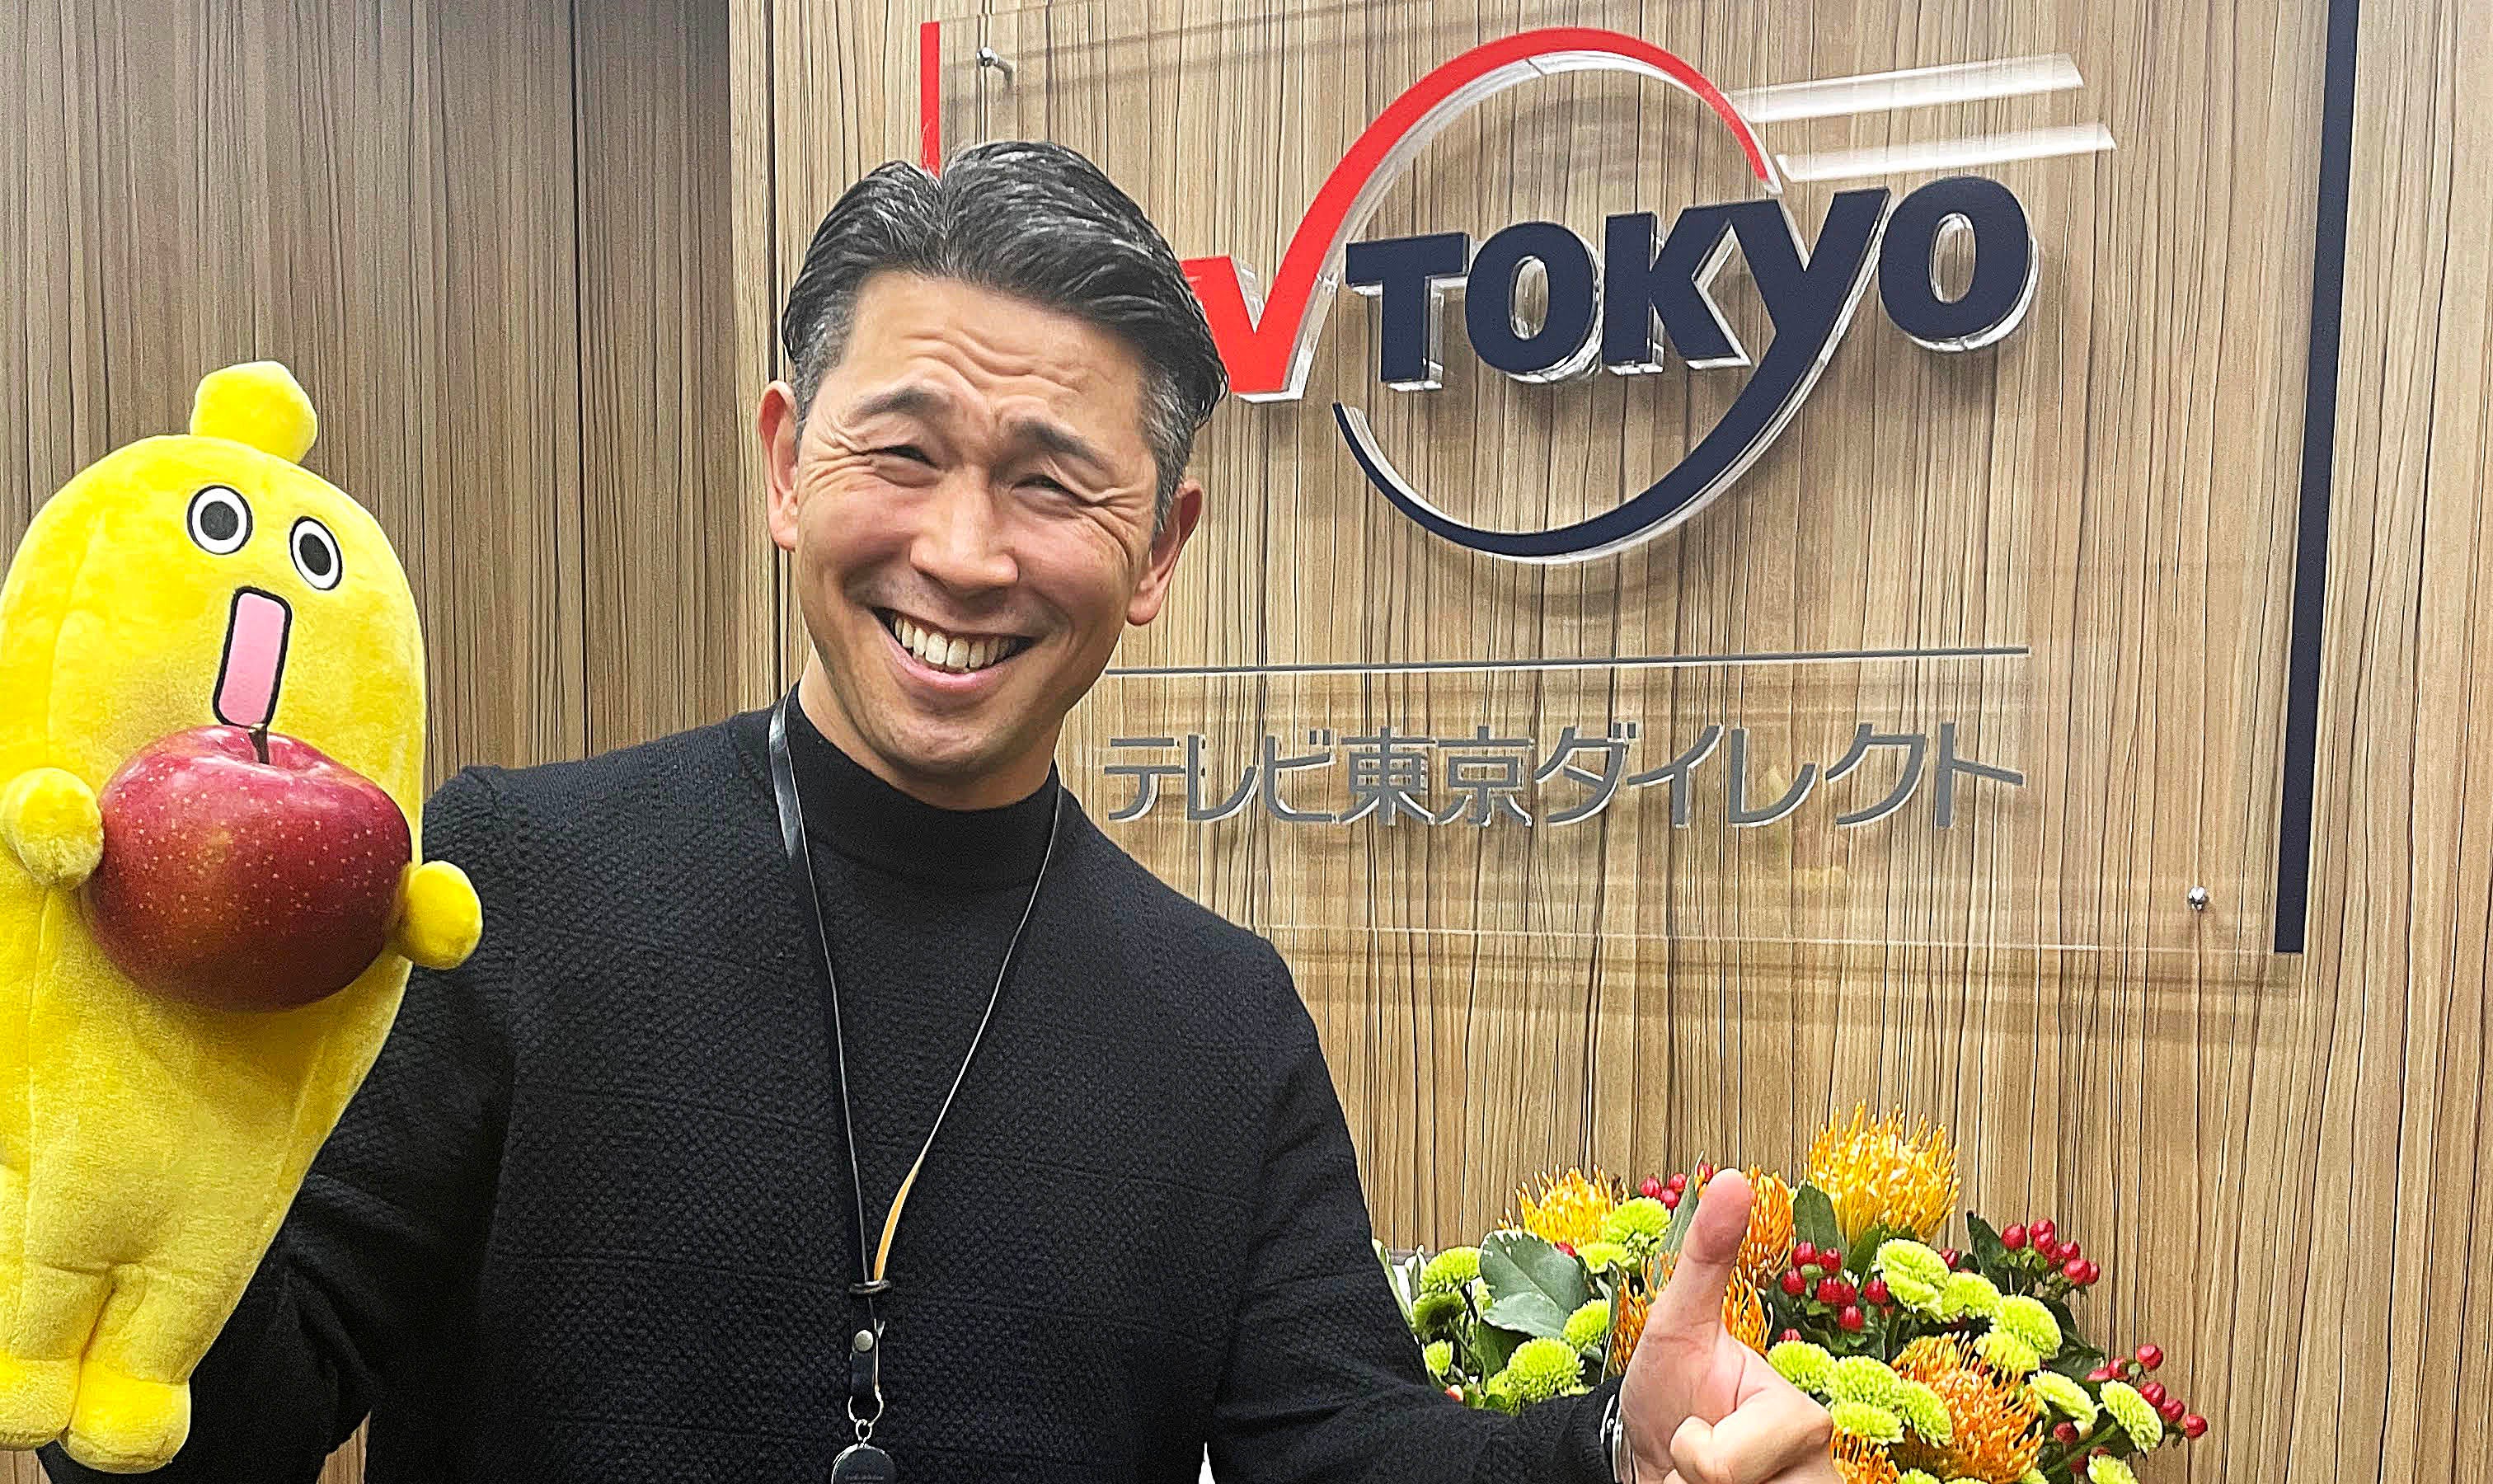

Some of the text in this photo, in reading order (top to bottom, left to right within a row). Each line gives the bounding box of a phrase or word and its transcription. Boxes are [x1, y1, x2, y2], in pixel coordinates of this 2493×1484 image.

[1336, 176, 2036, 556] TOKYO
[1103, 721, 2025, 828] テレビ東京ダイレクト
